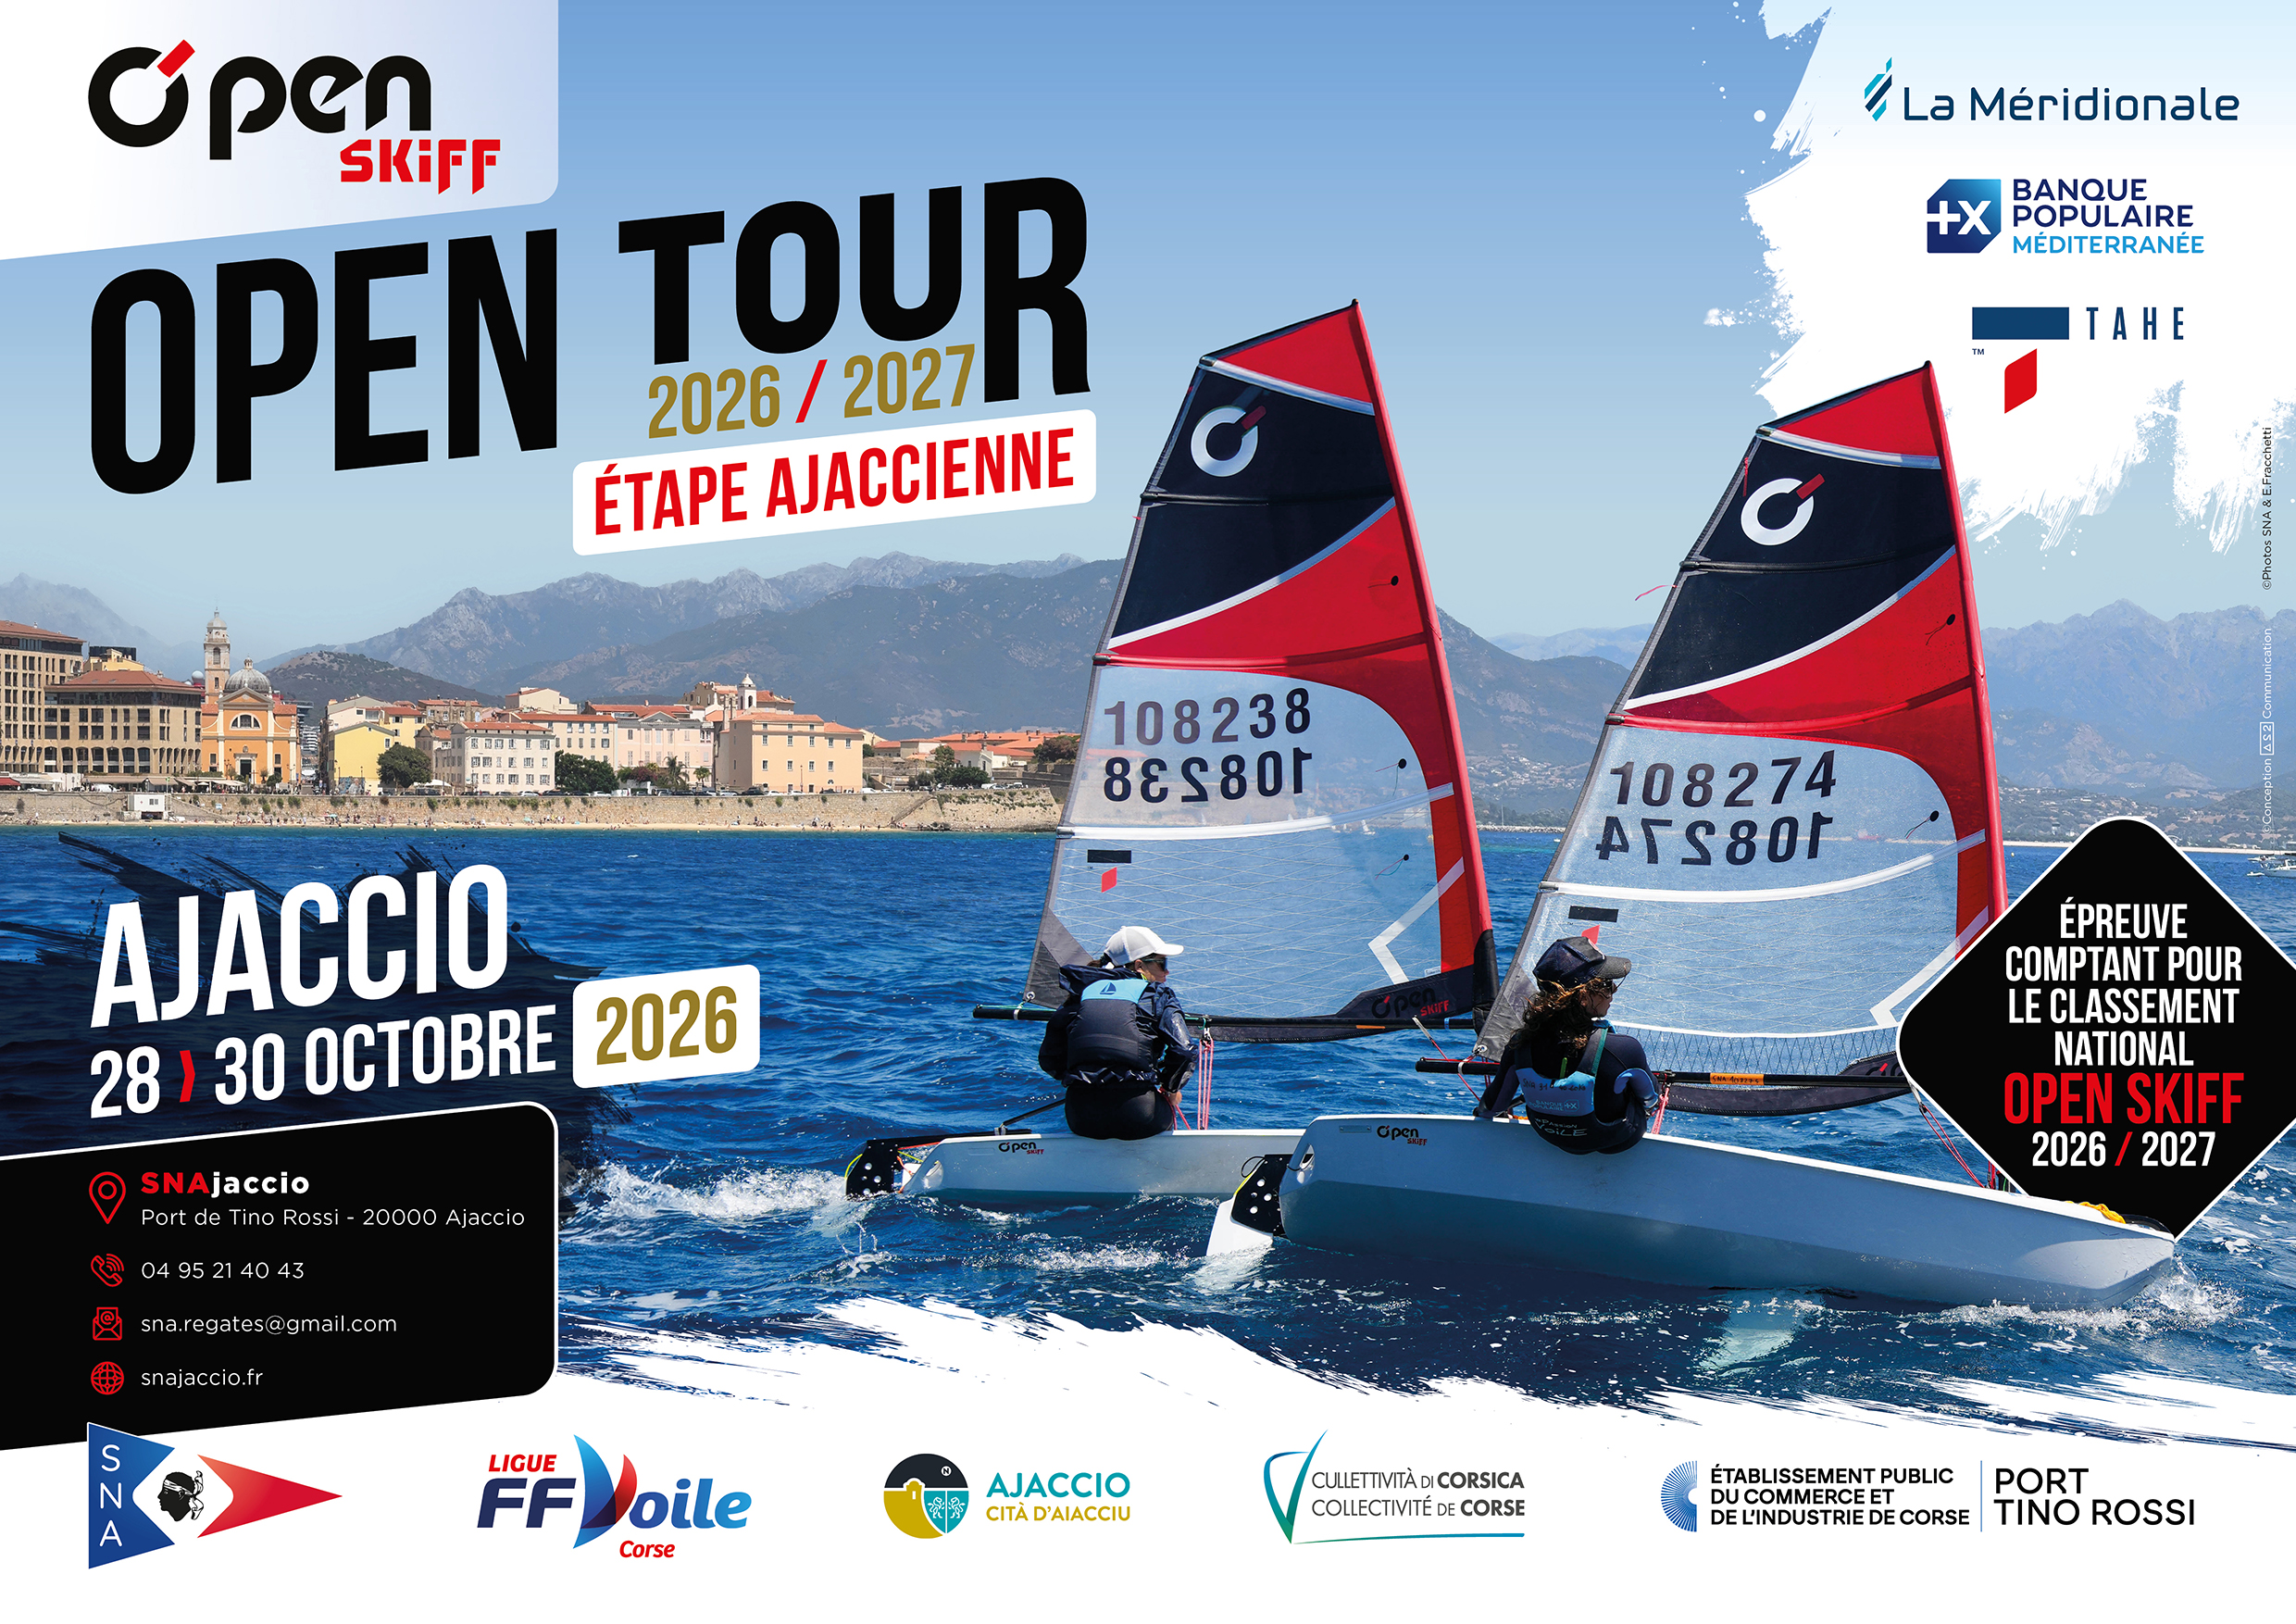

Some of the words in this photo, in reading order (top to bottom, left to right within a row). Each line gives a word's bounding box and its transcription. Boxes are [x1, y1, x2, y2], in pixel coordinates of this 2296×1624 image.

[1903, 87, 1954, 120] La
[1971, 86, 2240, 120] Méridionale
[2013, 179, 2147, 201] BANQUE
[2013, 205, 2194, 227] POPULAIRE
[2013, 231, 2204, 254] MÉDITERRANÉE
[92, 227, 557, 494] OPEN
[618, 177, 1091, 404] TOUR
[2086, 306, 2184, 340] TAHE
[648, 365, 780, 439] 2026
[795, 358, 828, 423] /
[843, 344, 976, 418] 2027
[595, 463, 747, 535] ÉTAPE
[766, 428, 1074, 518] AJACCIENNE
[1104, 688, 1311, 746] 108238
[1610, 750, 1836, 807] 108274
[2060, 897, 2188, 938] ÉPREUVE
[91, 864, 508, 1028] AJACCIO
[2005, 946, 2159, 981] COMPTANT
[2168, 946, 2242, 981] POUR
[2009, 988, 2040, 1023] LE
[2050, 988, 2240, 1023] CLASSEMENT
[595, 985, 737, 1066] 2026
[91, 1045, 160, 1119] 28
[215, 1032, 285, 1106] 30
[305, 1004, 556, 1095] OCTOBRE
[2054, 1031, 2193, 1066] NATIONAL
[2004, 1072, 2112, 1124] OPEN
[2127, 1072, 2244, 1124] SKIFF
[2032, 1131, 2105, 1167] 2026
[2115, 1131, 2133, 1167] /
[2141, 1131, 2215, 1167] 2027
[141, 1172, 310, 1198] SNAjaccio
[142, 1209, 186, 1226] Port
[194, 1209, 220, 1226] de
[229, 1209, 274, 1226] Tino
[283, 1209, 339, 1226] Rossi
[362, 1209, 437, 1226] 20000
[445, 1208, 525, 1229] Ajaccio
[142, 1262, 170, 1280] 04
[178, 1262, 205, 1280] 95
[212, 1262, 232, 1280] 21
[240, 1262, 269, 1280] 40
[277, 1262, 305, 1280] 43
[141, 1316, 397, 1335] sna.regates@gmail.com
[141, 1368, 263, 1389] snajaccio.fr
[489, 1454, 556, 1472] LIGUE
[1710, 1463, 1877, 1484] ÉTABLISSEMENT
[1880, 1468, 1953, 1484] PUBLIC
[986, 1472, 1130, 1499] AJACCIO
[1311, 1467, 1416, 1490] CULLETTIVITÀ
[1421, 1475, 1434, 1489] DI
[1438, 1471, 1525, 1490] CORSICA
[1995, 1468, 2089, 1494] PORT
[1311, 1494, 1432, 1518] COLLECTIVITÉ
[1437, 1503, 1455, 1517] DE
[1460, 1499, 1526, 1518] CORSE
[1710, 1489, 1741, 1505] DU
[1743, 1489, 1866, 1505] COMMERCE
[1871, 1489, 1894, 1505] ET
[985, 1502, 1027, 1522] CITÀ
[1710, 1509, 1739, 1526] DE
[1868, 1509, 1895, 1526] DE
[1899, 1509, 1970, 1526] CORSE
[1993, 1499, 2080, 1526] TINO
[2091, 1499, 2195, 1526] ROSSI
[618, 1540, 676, 1558] Corse
